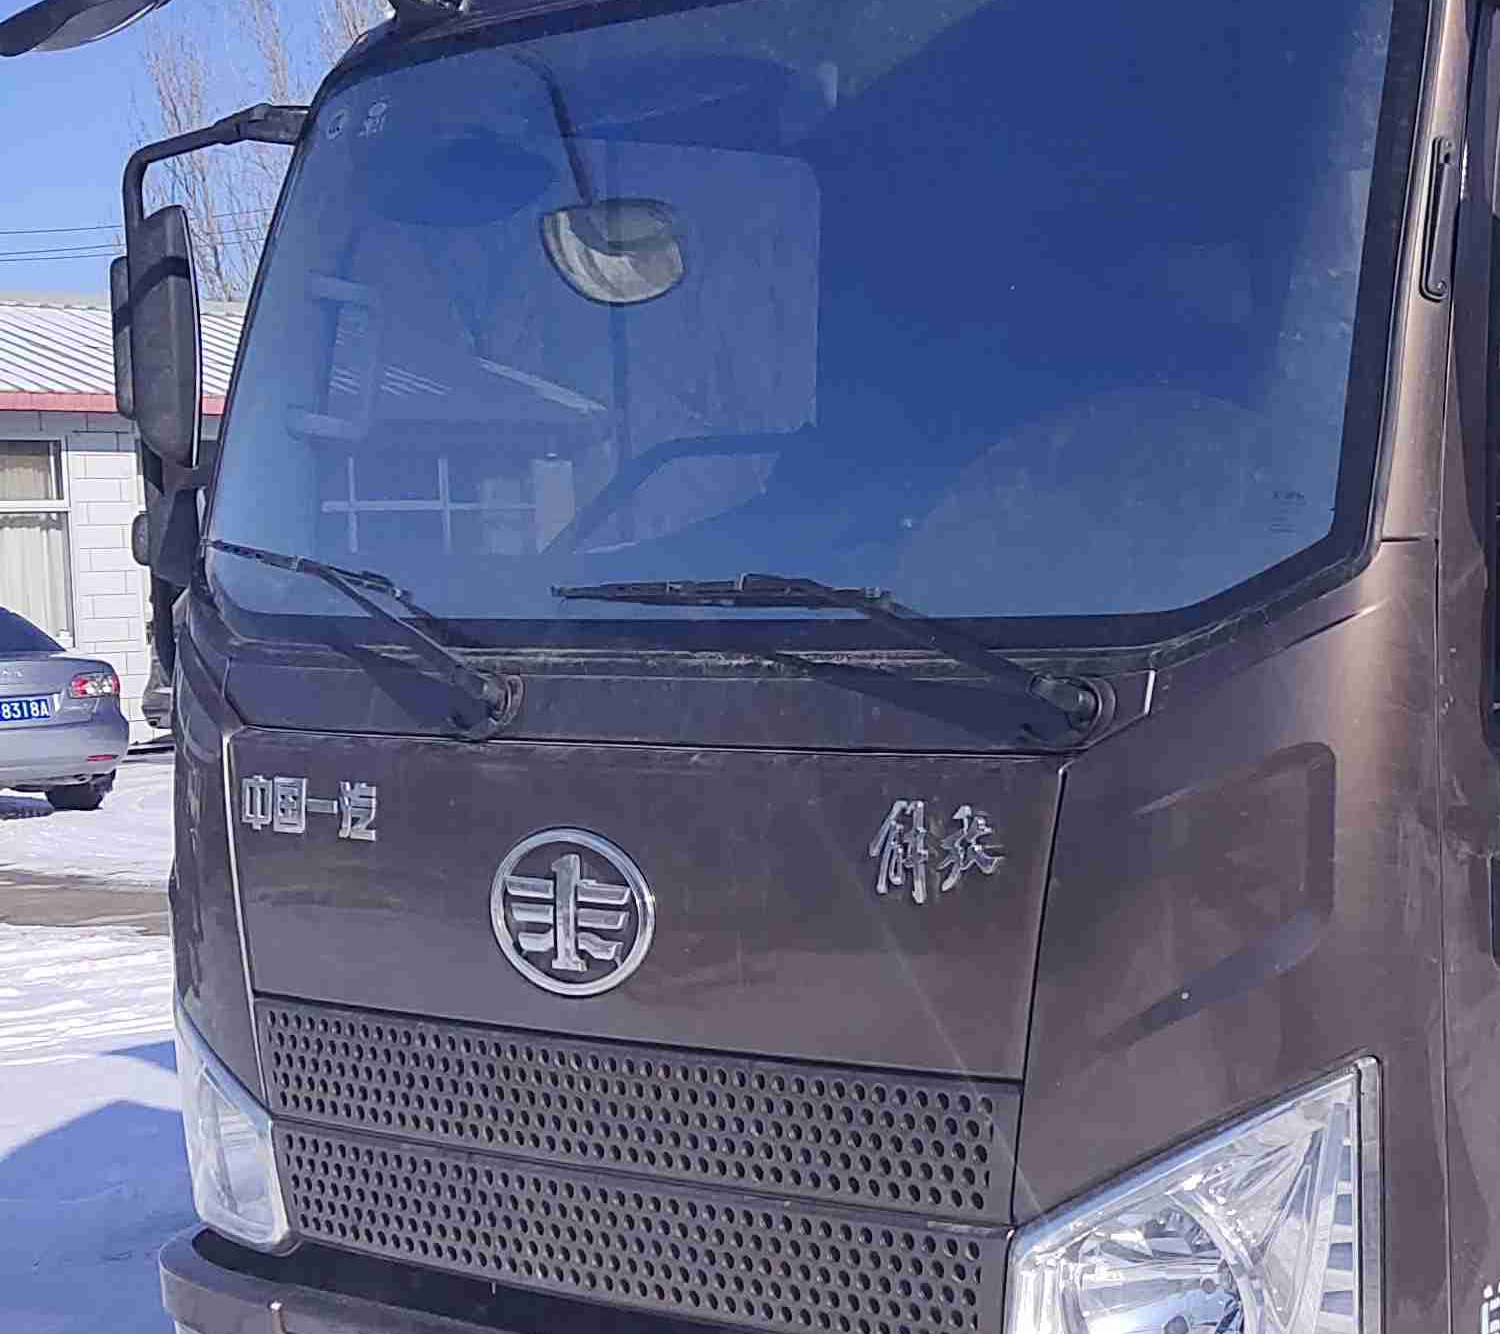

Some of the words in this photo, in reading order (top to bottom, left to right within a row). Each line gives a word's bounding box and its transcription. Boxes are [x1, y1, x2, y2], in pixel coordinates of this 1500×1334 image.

[241, 774, 377, 841] 中国一汽
[869, 799, 1005, 905] 解放
